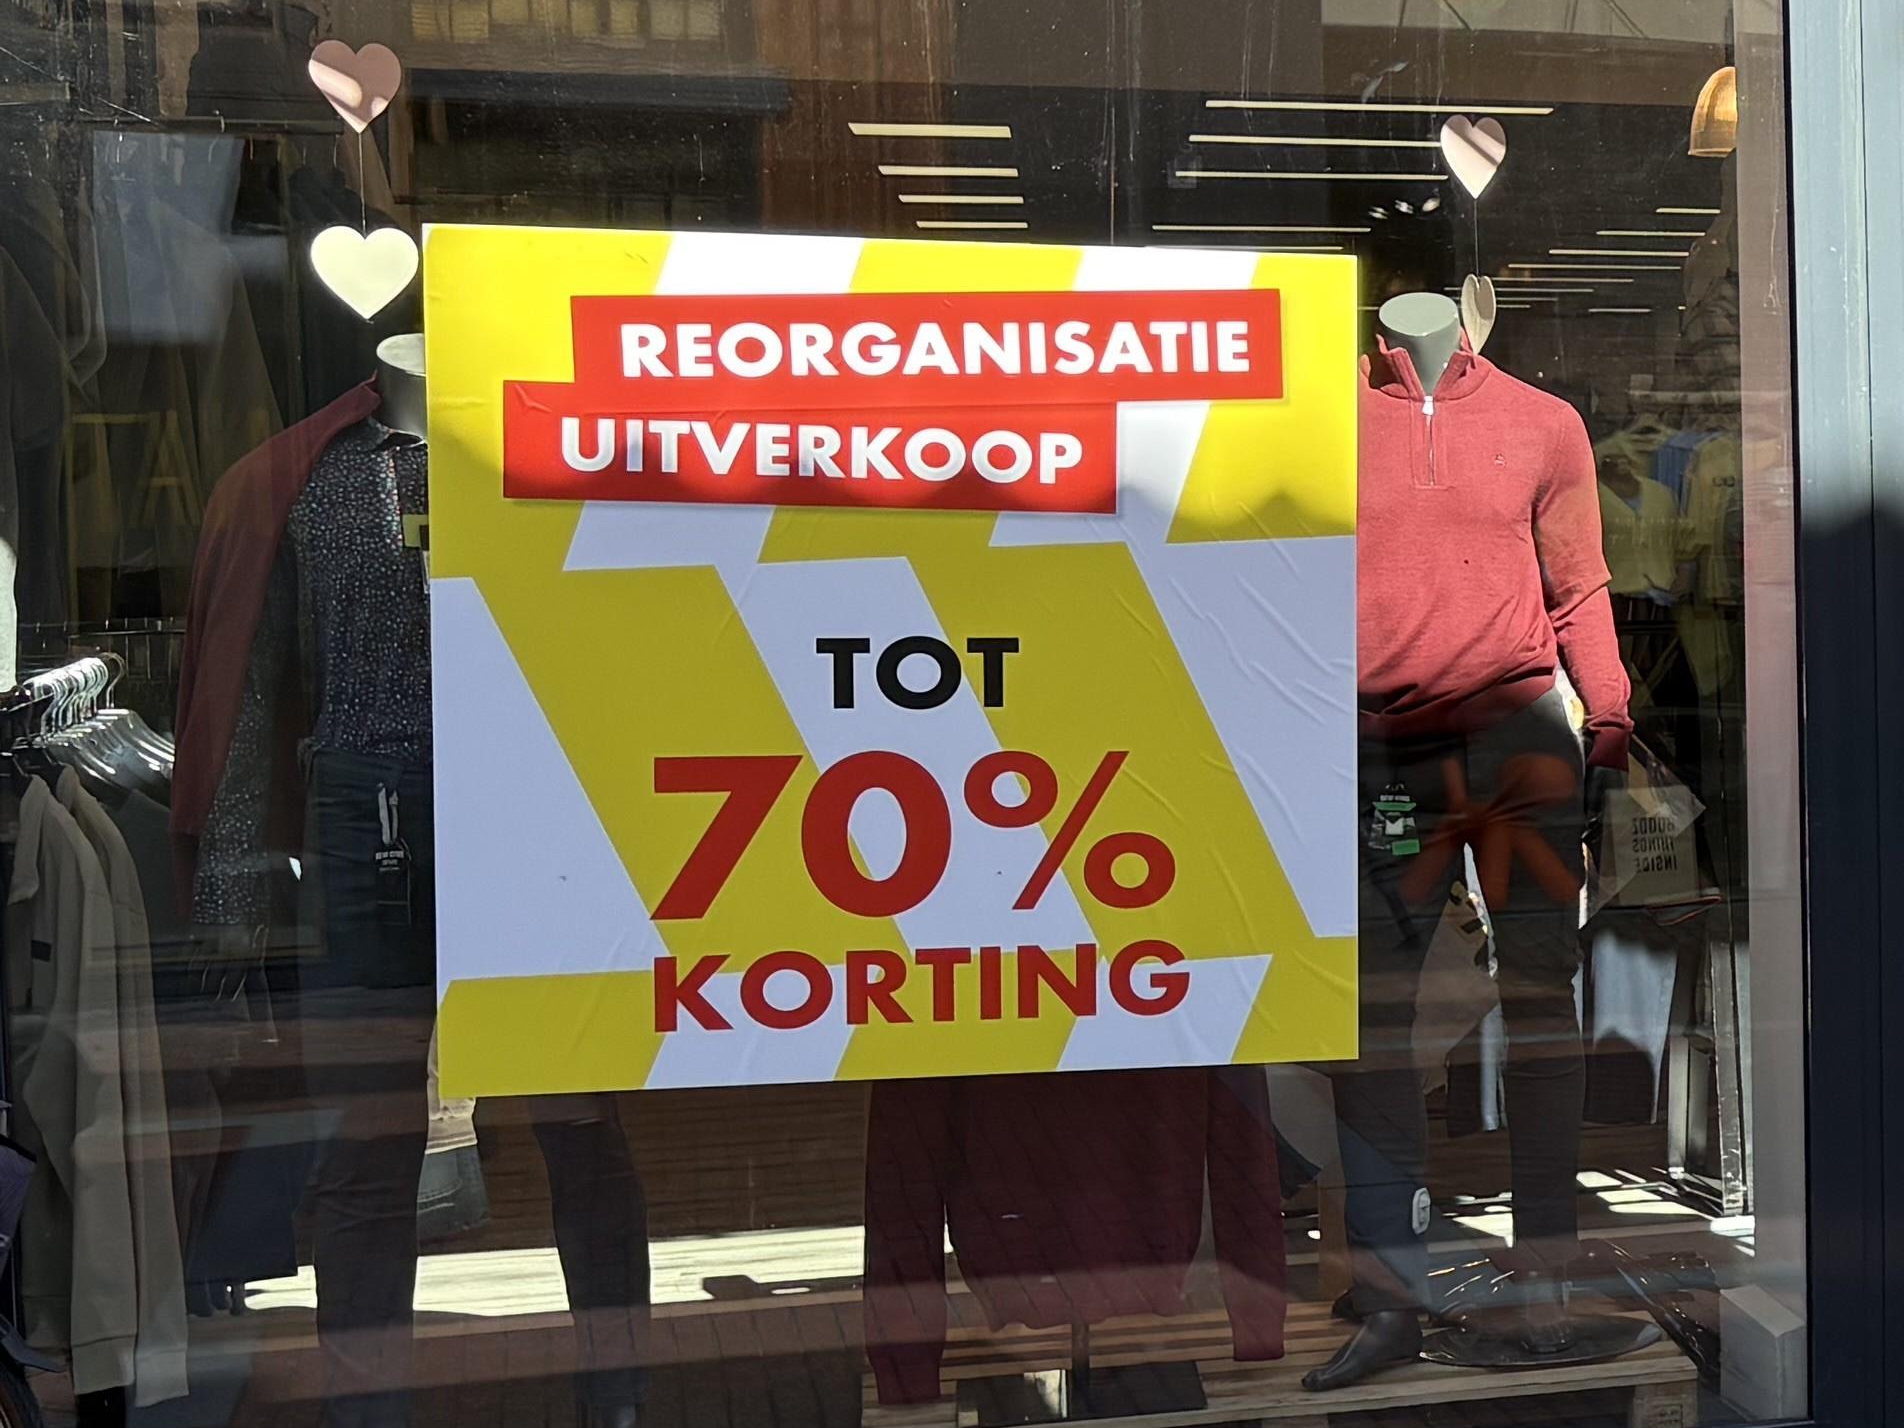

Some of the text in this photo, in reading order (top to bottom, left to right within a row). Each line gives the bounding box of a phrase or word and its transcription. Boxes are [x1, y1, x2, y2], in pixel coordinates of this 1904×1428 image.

[620, 320, 1250, 379] REORGANISATIE
[560, 416, 1084, 485] UITVERKOOP
[815, 637, 1020, 711] TOT
[650, 749, 1177, 921] 70%
[653, 939, 1191, 1033] KORTING
